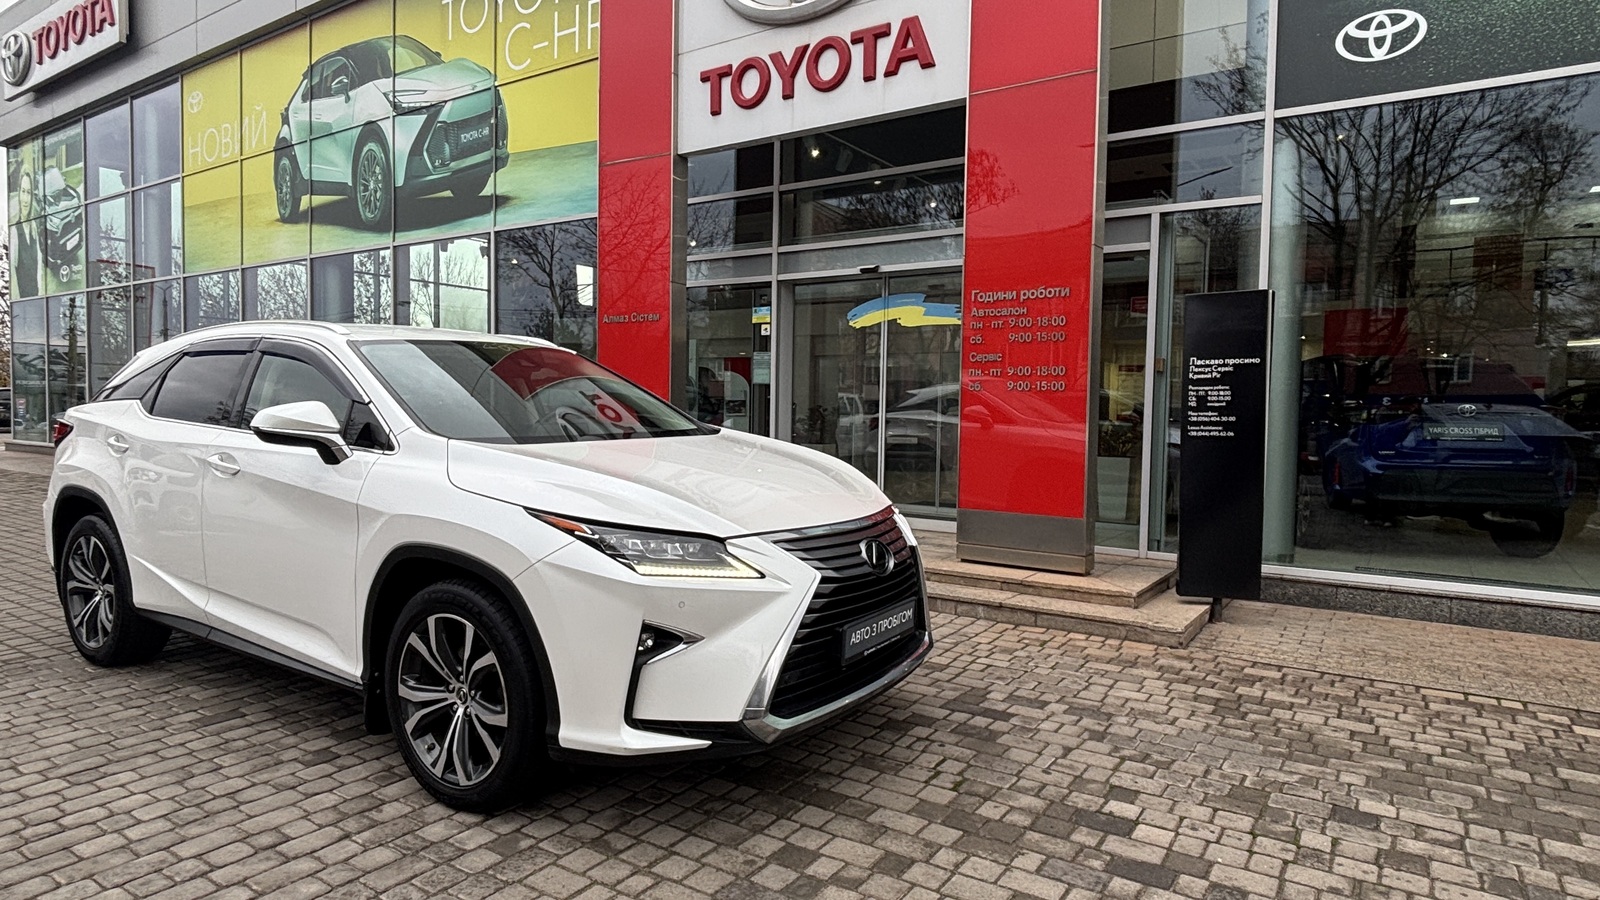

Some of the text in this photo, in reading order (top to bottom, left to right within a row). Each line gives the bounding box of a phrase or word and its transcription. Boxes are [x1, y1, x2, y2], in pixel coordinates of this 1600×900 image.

[32, 0, 116, 66] TOYOTA
[700, 15, 936, 116] TOYOTA
[188, 103, 268, 167] НОВИЙ
[971, 286, 1070, 303] Години роботи
[602, 312, 660, 324] Алмаз Сістем
[970, 306, 1027, 317] Автосалон
[969, 352, 1003, 363] Сервіс
[1189, 357, 1261, 366] Ласкаво просимо
[849, 626, 871, 646] АВТО
[877, 607, 913, 634] ПРОБІГОМ
